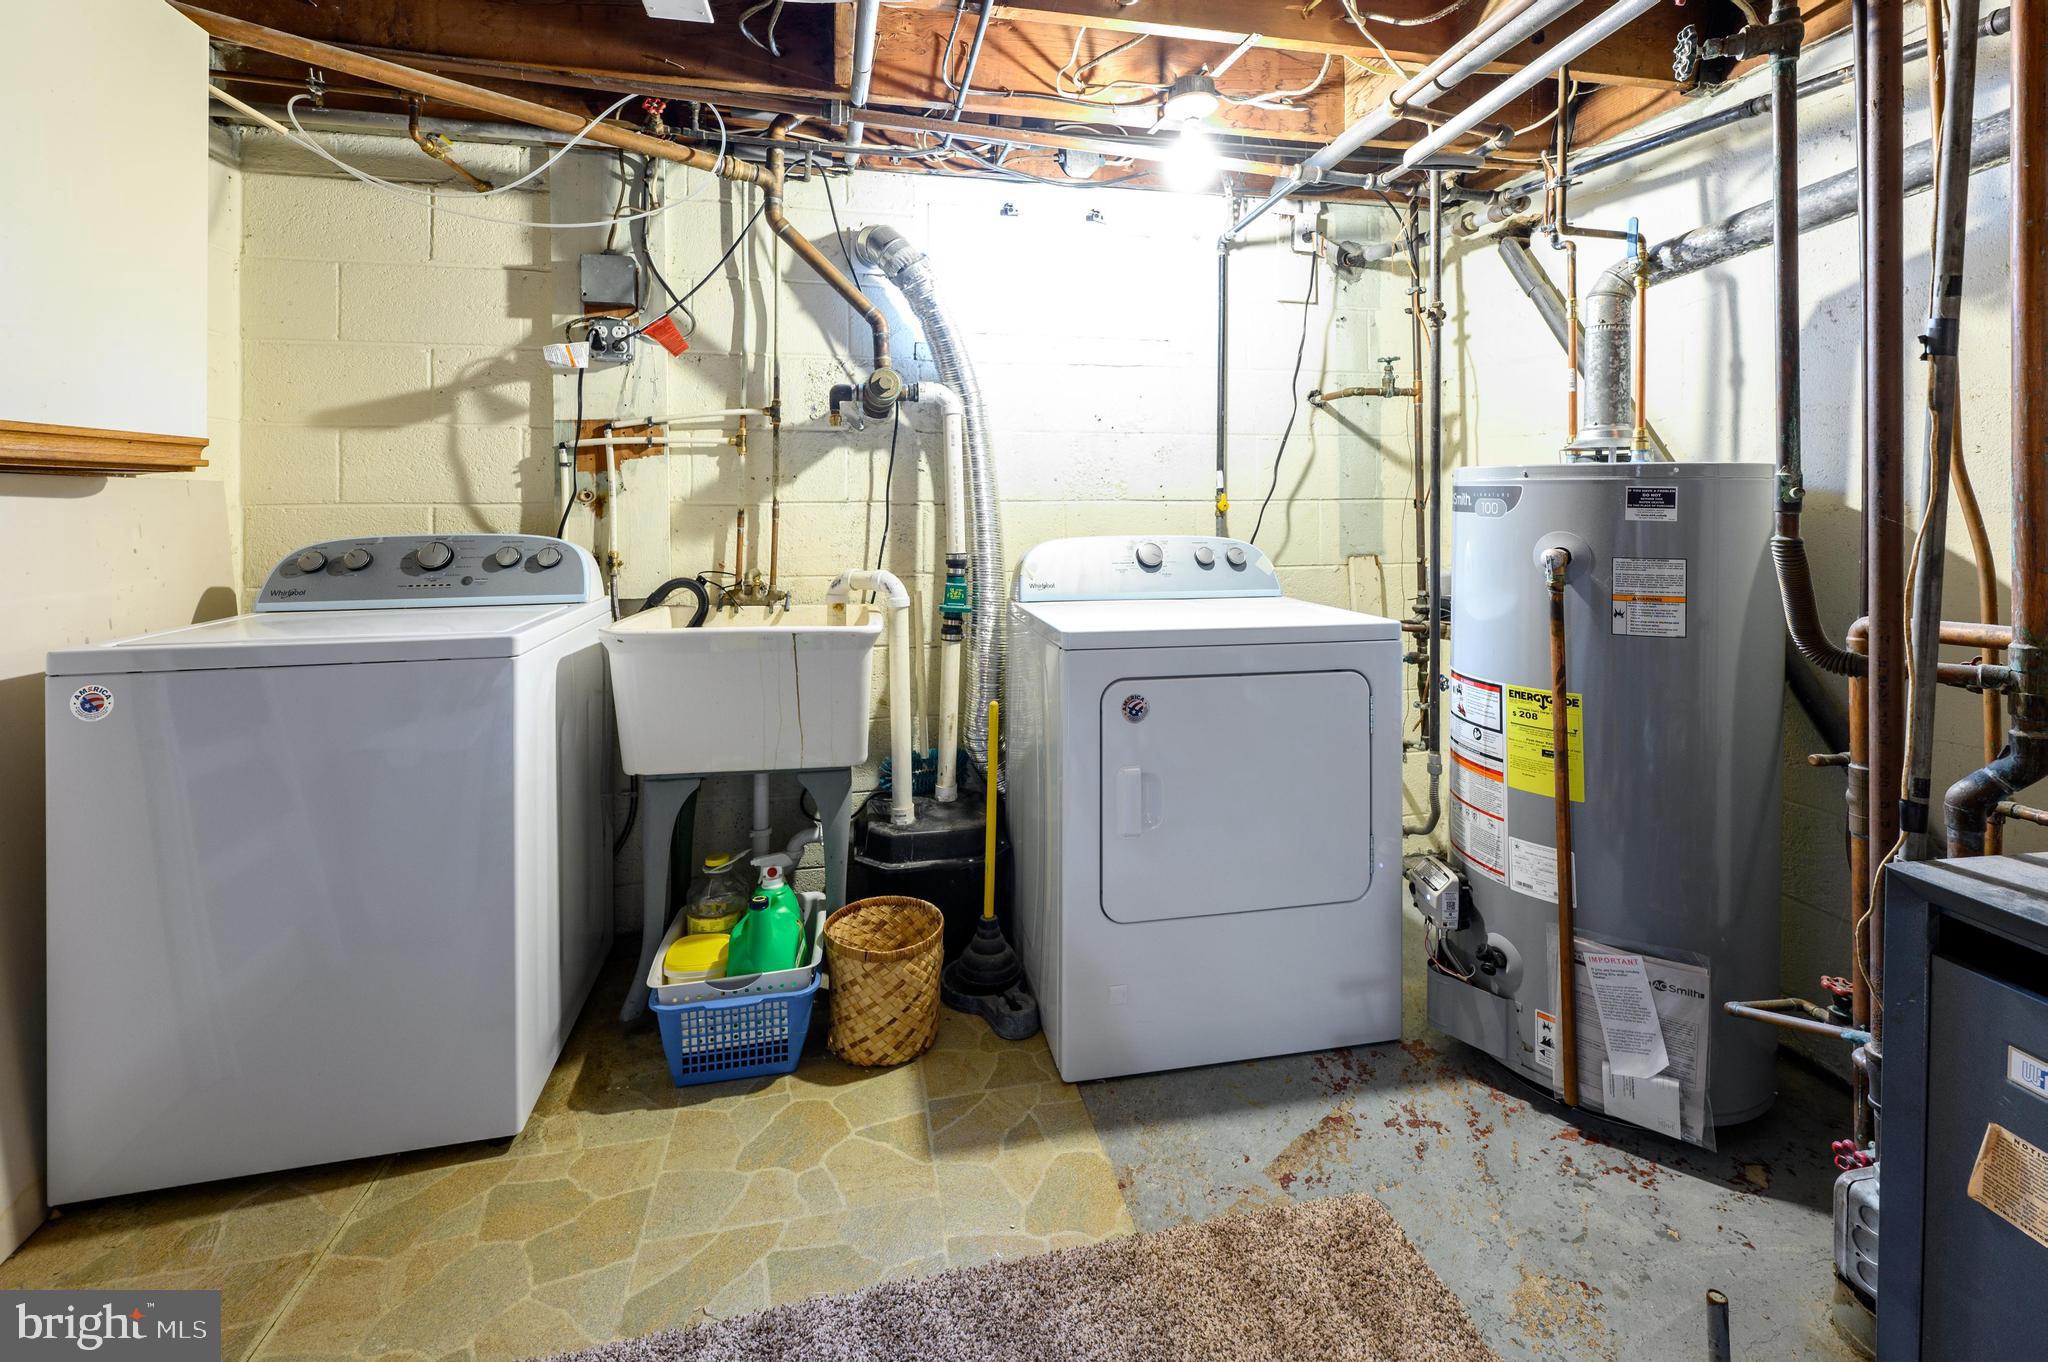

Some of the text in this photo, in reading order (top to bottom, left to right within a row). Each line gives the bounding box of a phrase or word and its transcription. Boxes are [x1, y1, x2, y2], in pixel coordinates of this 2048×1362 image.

[1481, 502, 1499, 514] 100
[1028, 582, 1056, 591] Whirlpool
[270, 588, 306, 599] Whirlpool
[74, 686, 112, 701] AMERICA
[1508, 689, 1580, 708] ENERGYGDE
[1519, 710, 1538, 720] 208
[1588, 956, 1639, 966] IMPORTANT
[1668, 984, 1701, 999] Smith
